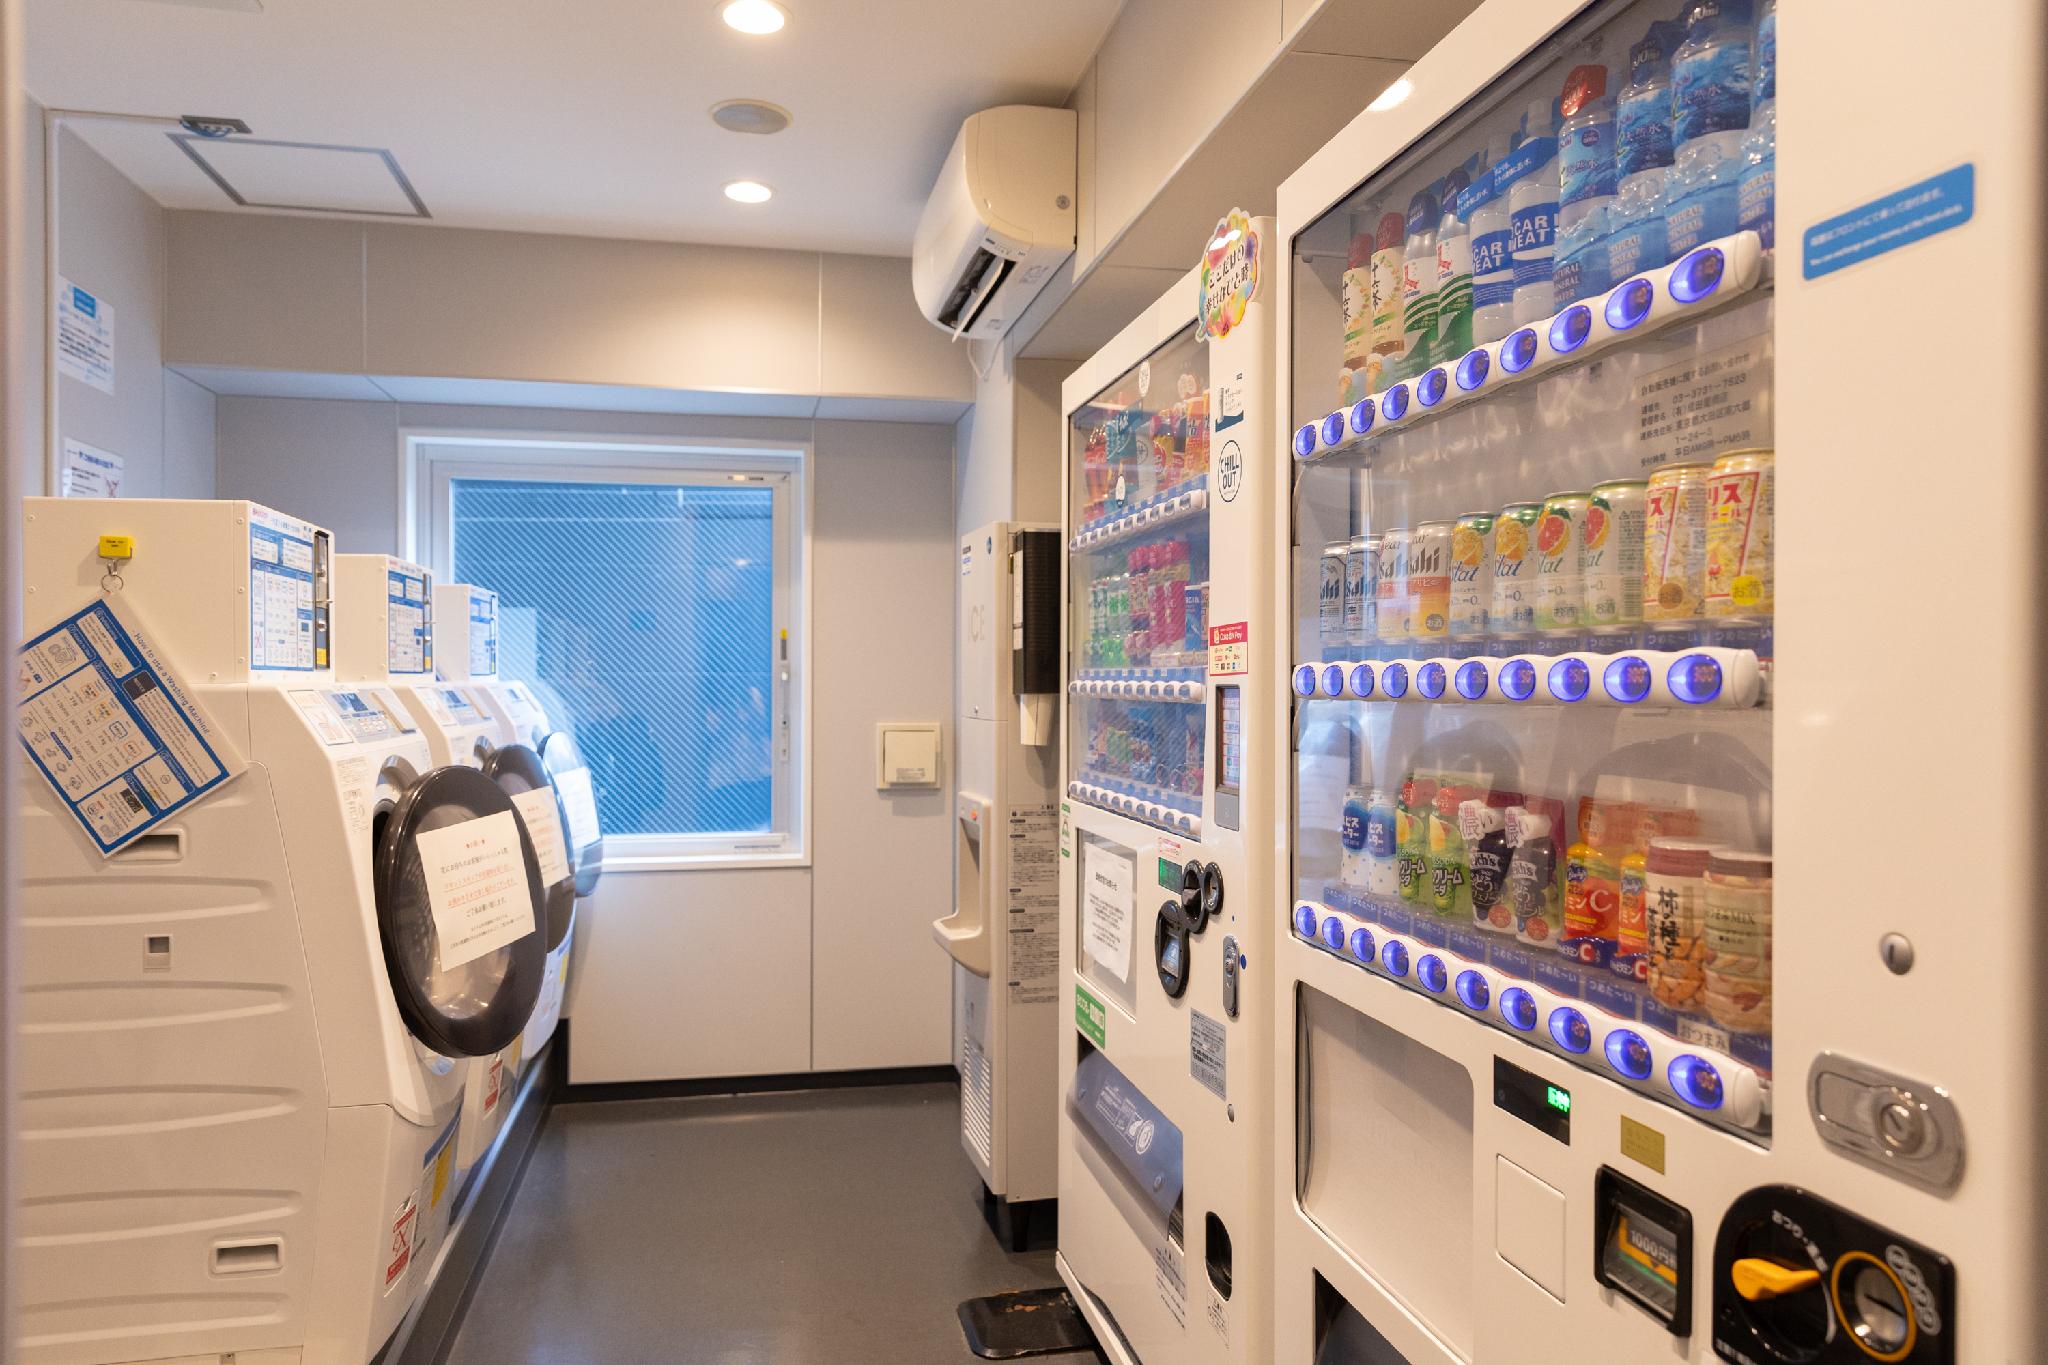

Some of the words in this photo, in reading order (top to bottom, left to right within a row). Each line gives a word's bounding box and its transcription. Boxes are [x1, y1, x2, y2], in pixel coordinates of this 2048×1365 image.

[1208, 244, 1245, 289] ここだけの
[1220, 453, 1239, 475] CHILL
[1222, 471, 1237, 490] OUT
[134, 633, 148, 650] How
[152, 657, 164, 672] use
[166, 675, 189, 706] Washing
[187, 704, 211, 734] Machine
[1590, 889, 1612, 913] C
[1679, 1019, 1729, 1051] おつまみ
